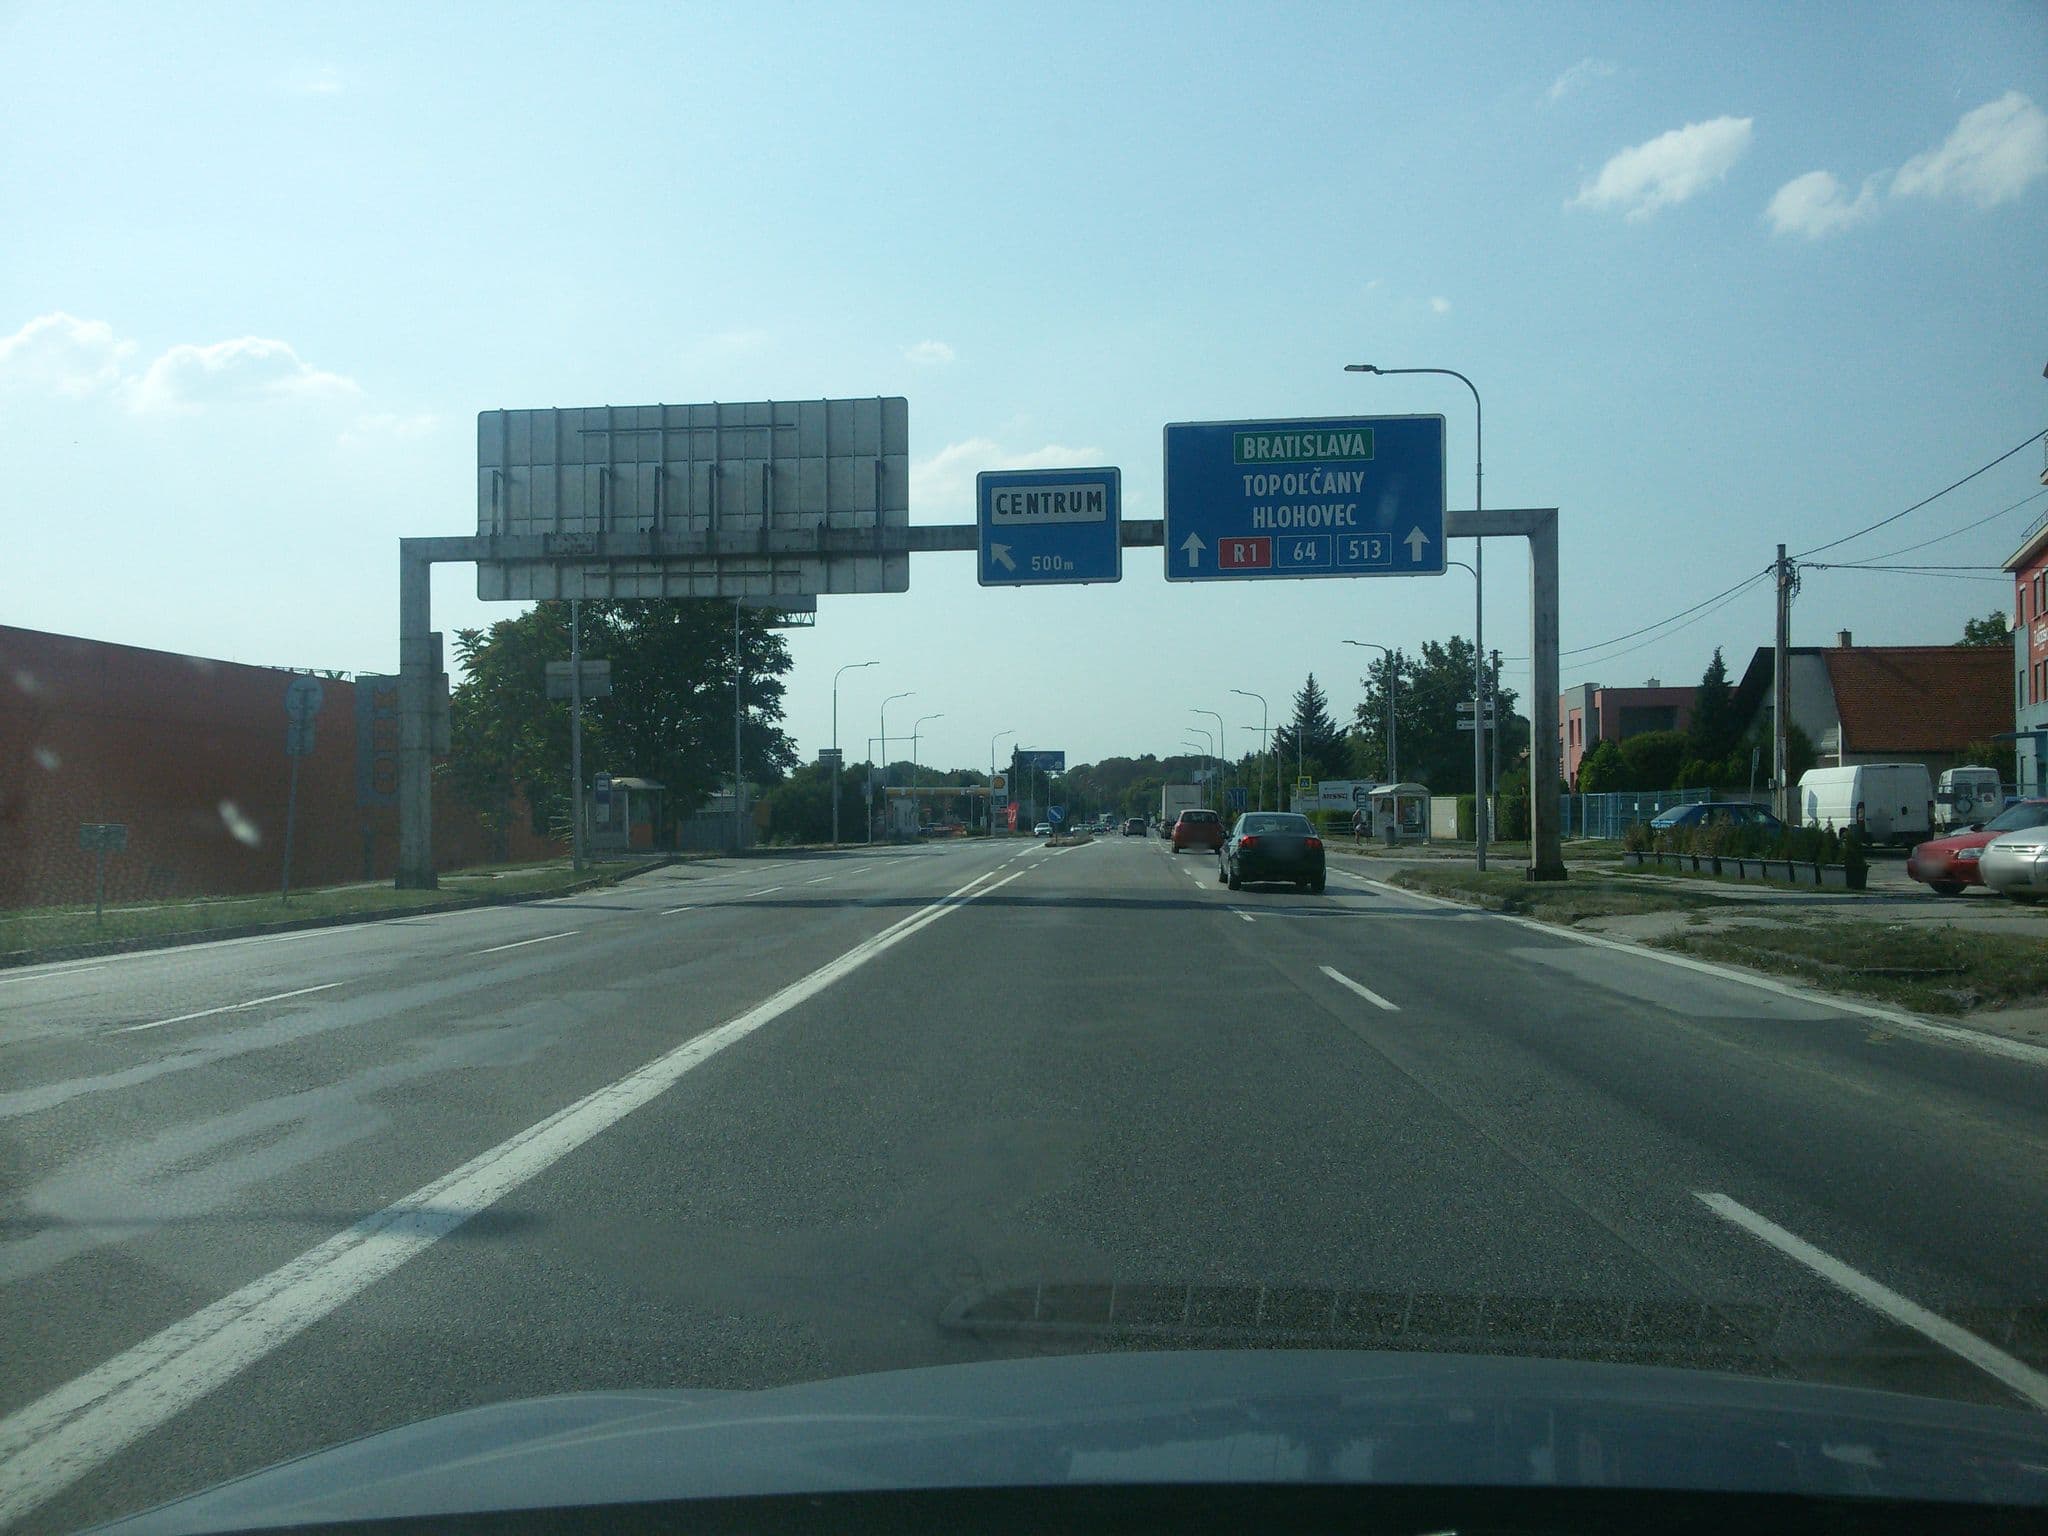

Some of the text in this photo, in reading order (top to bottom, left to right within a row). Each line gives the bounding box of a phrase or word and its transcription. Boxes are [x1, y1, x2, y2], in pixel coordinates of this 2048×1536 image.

[1243, 433, 1366, 459] BRATISLAVA
[1242, 467, 1365, 497] TOPOĽČANY
[996, 491, 1102, 515] CENTRUM
[1252, 503, 1357, 529] HLOHOVEC
[1031, 555, 1075, 571] 500m
[1233, 539, 1382, 563] R1 64 513
